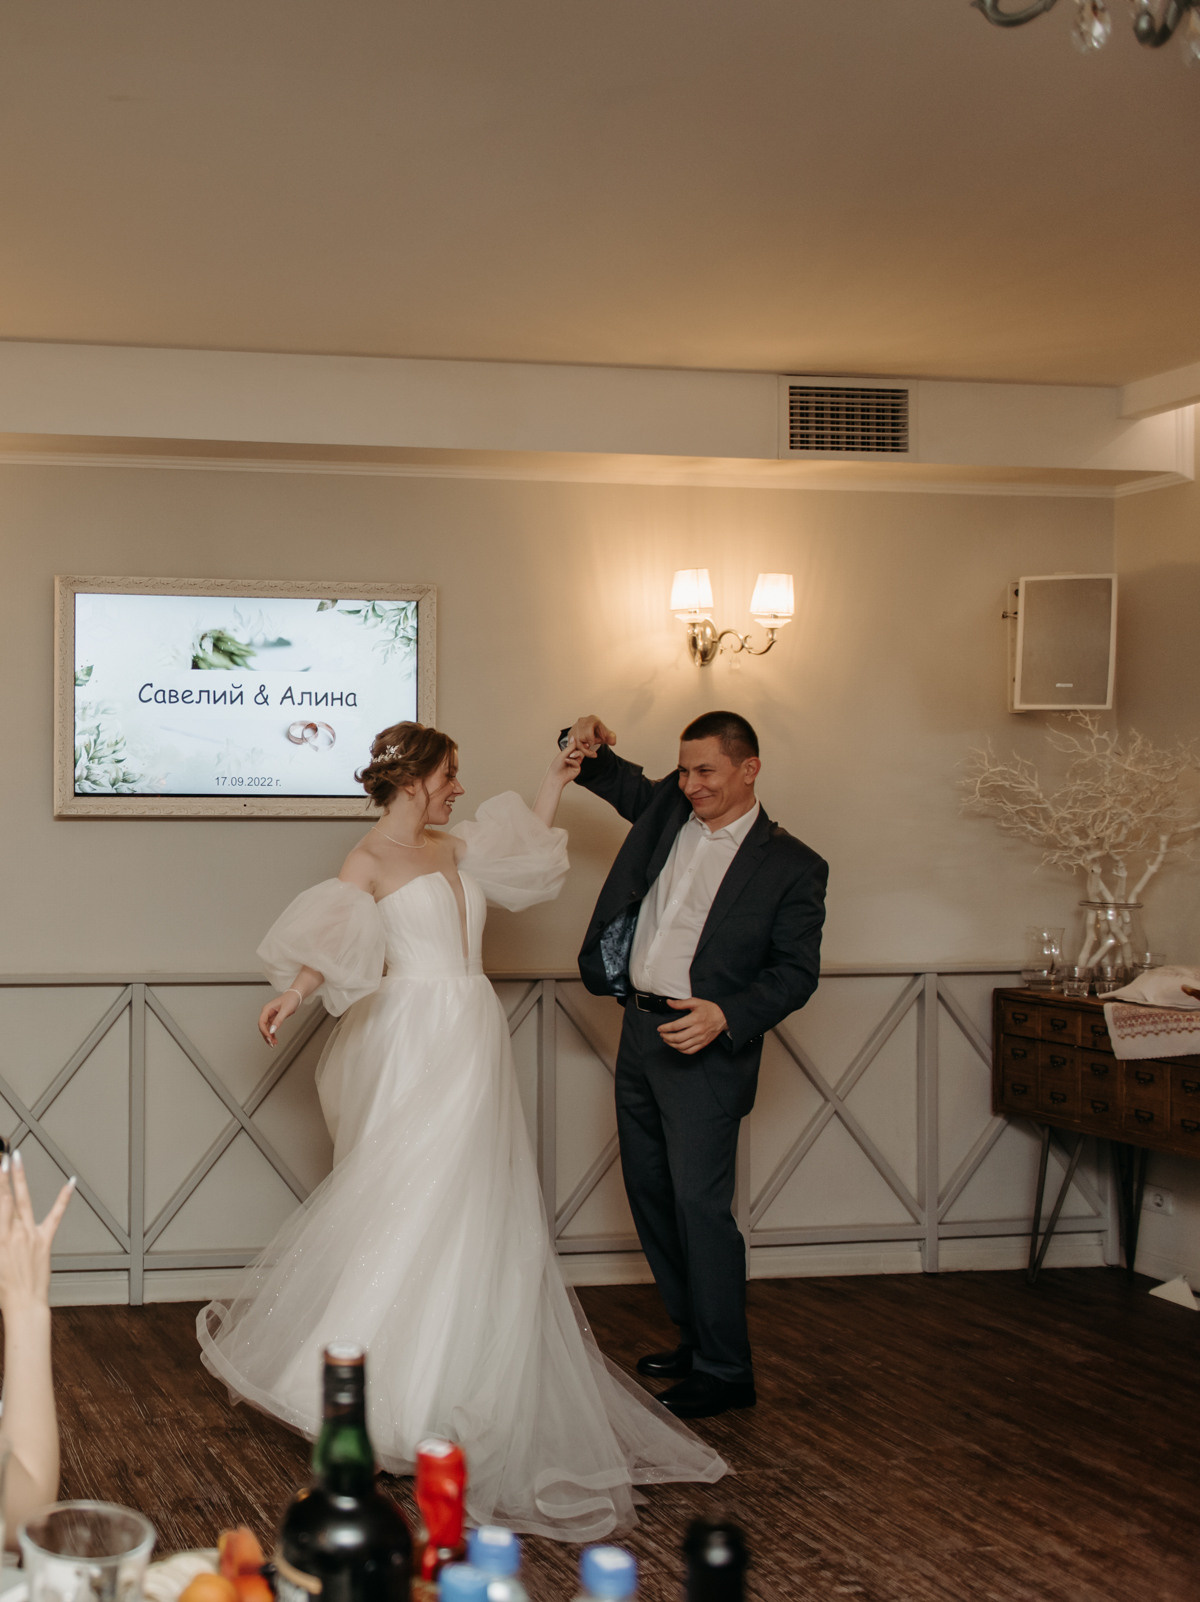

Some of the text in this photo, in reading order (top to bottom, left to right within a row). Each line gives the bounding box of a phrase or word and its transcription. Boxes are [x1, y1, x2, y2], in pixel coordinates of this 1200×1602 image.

[138, 682, 358, 707] Савелий & Алина
[215, 776, 273, 787] 17.09.2022
